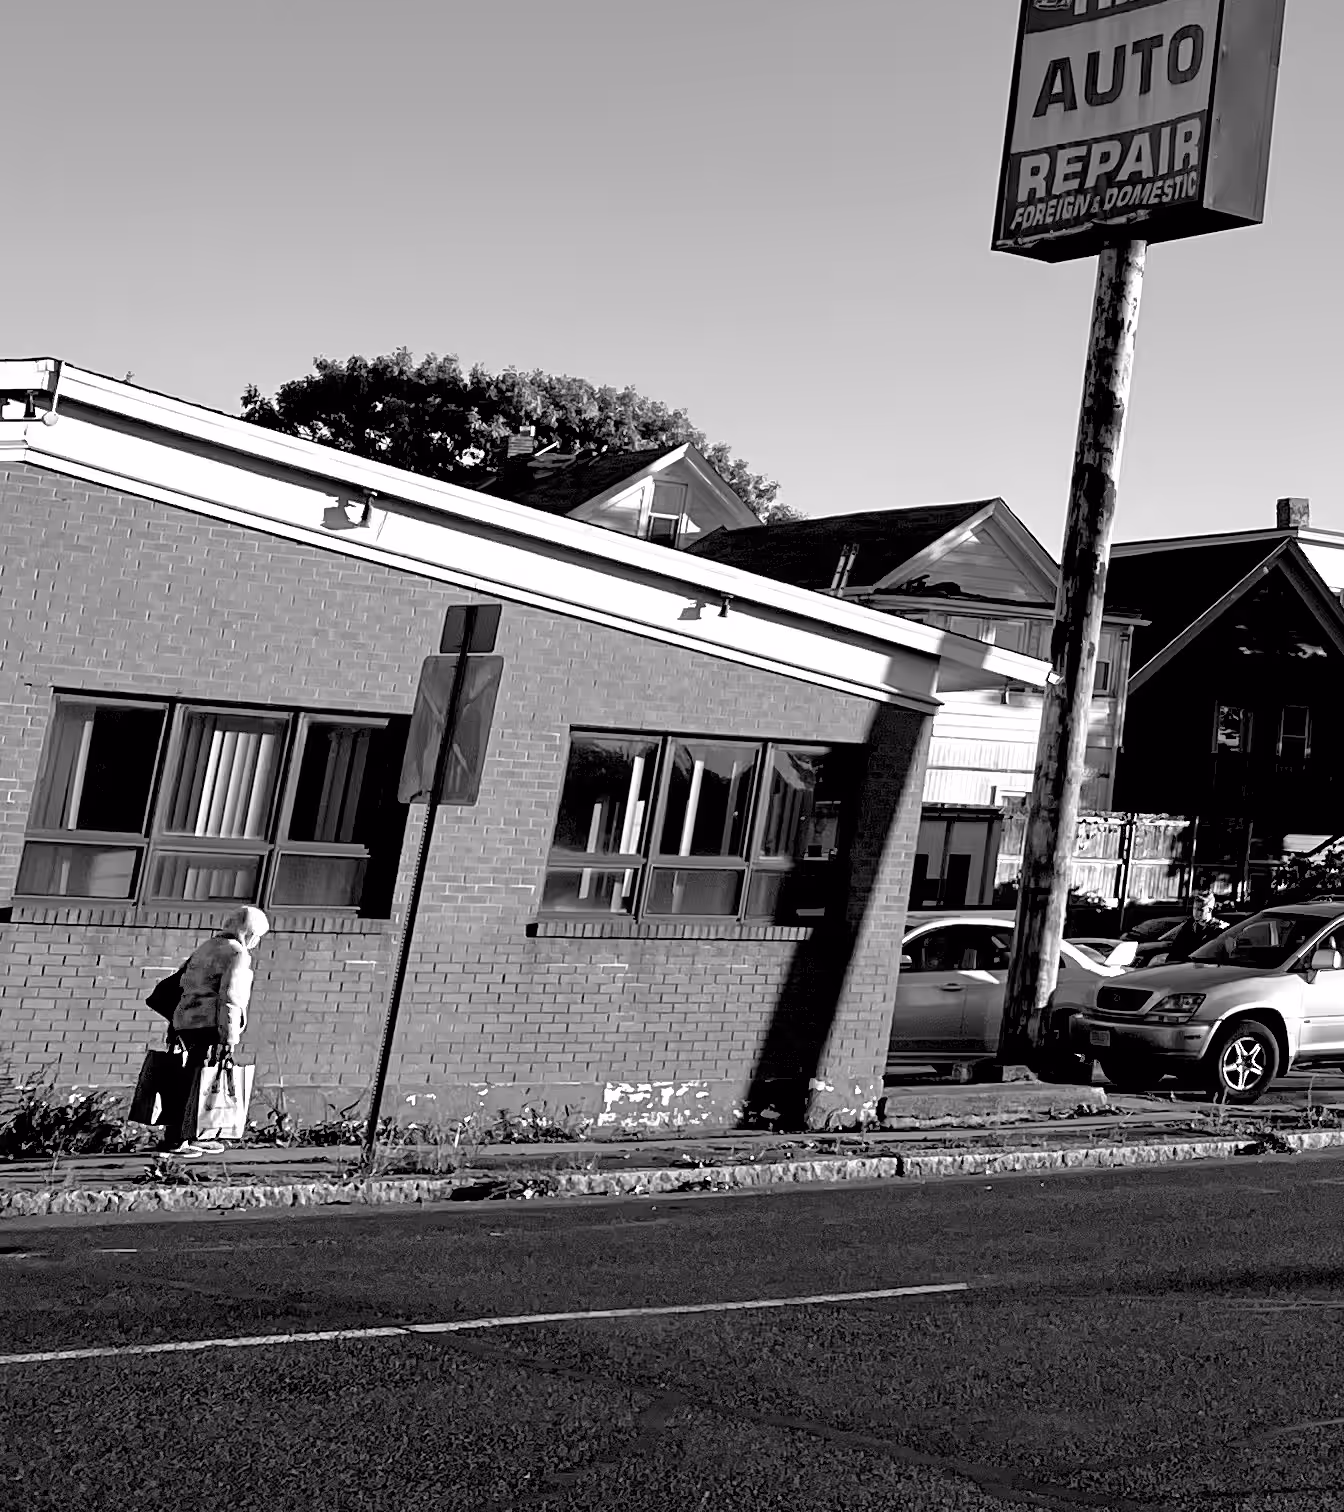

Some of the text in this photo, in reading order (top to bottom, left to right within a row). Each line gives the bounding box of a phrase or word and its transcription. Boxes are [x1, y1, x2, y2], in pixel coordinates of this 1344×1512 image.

[1031, 23, 1205, 119] AUTO
[1010, 193, 1092, 231] FOREIGN
[1103, 171, 1198, 211] DOMESTIC
[1016, 117, 1202, 204] REPAIR
